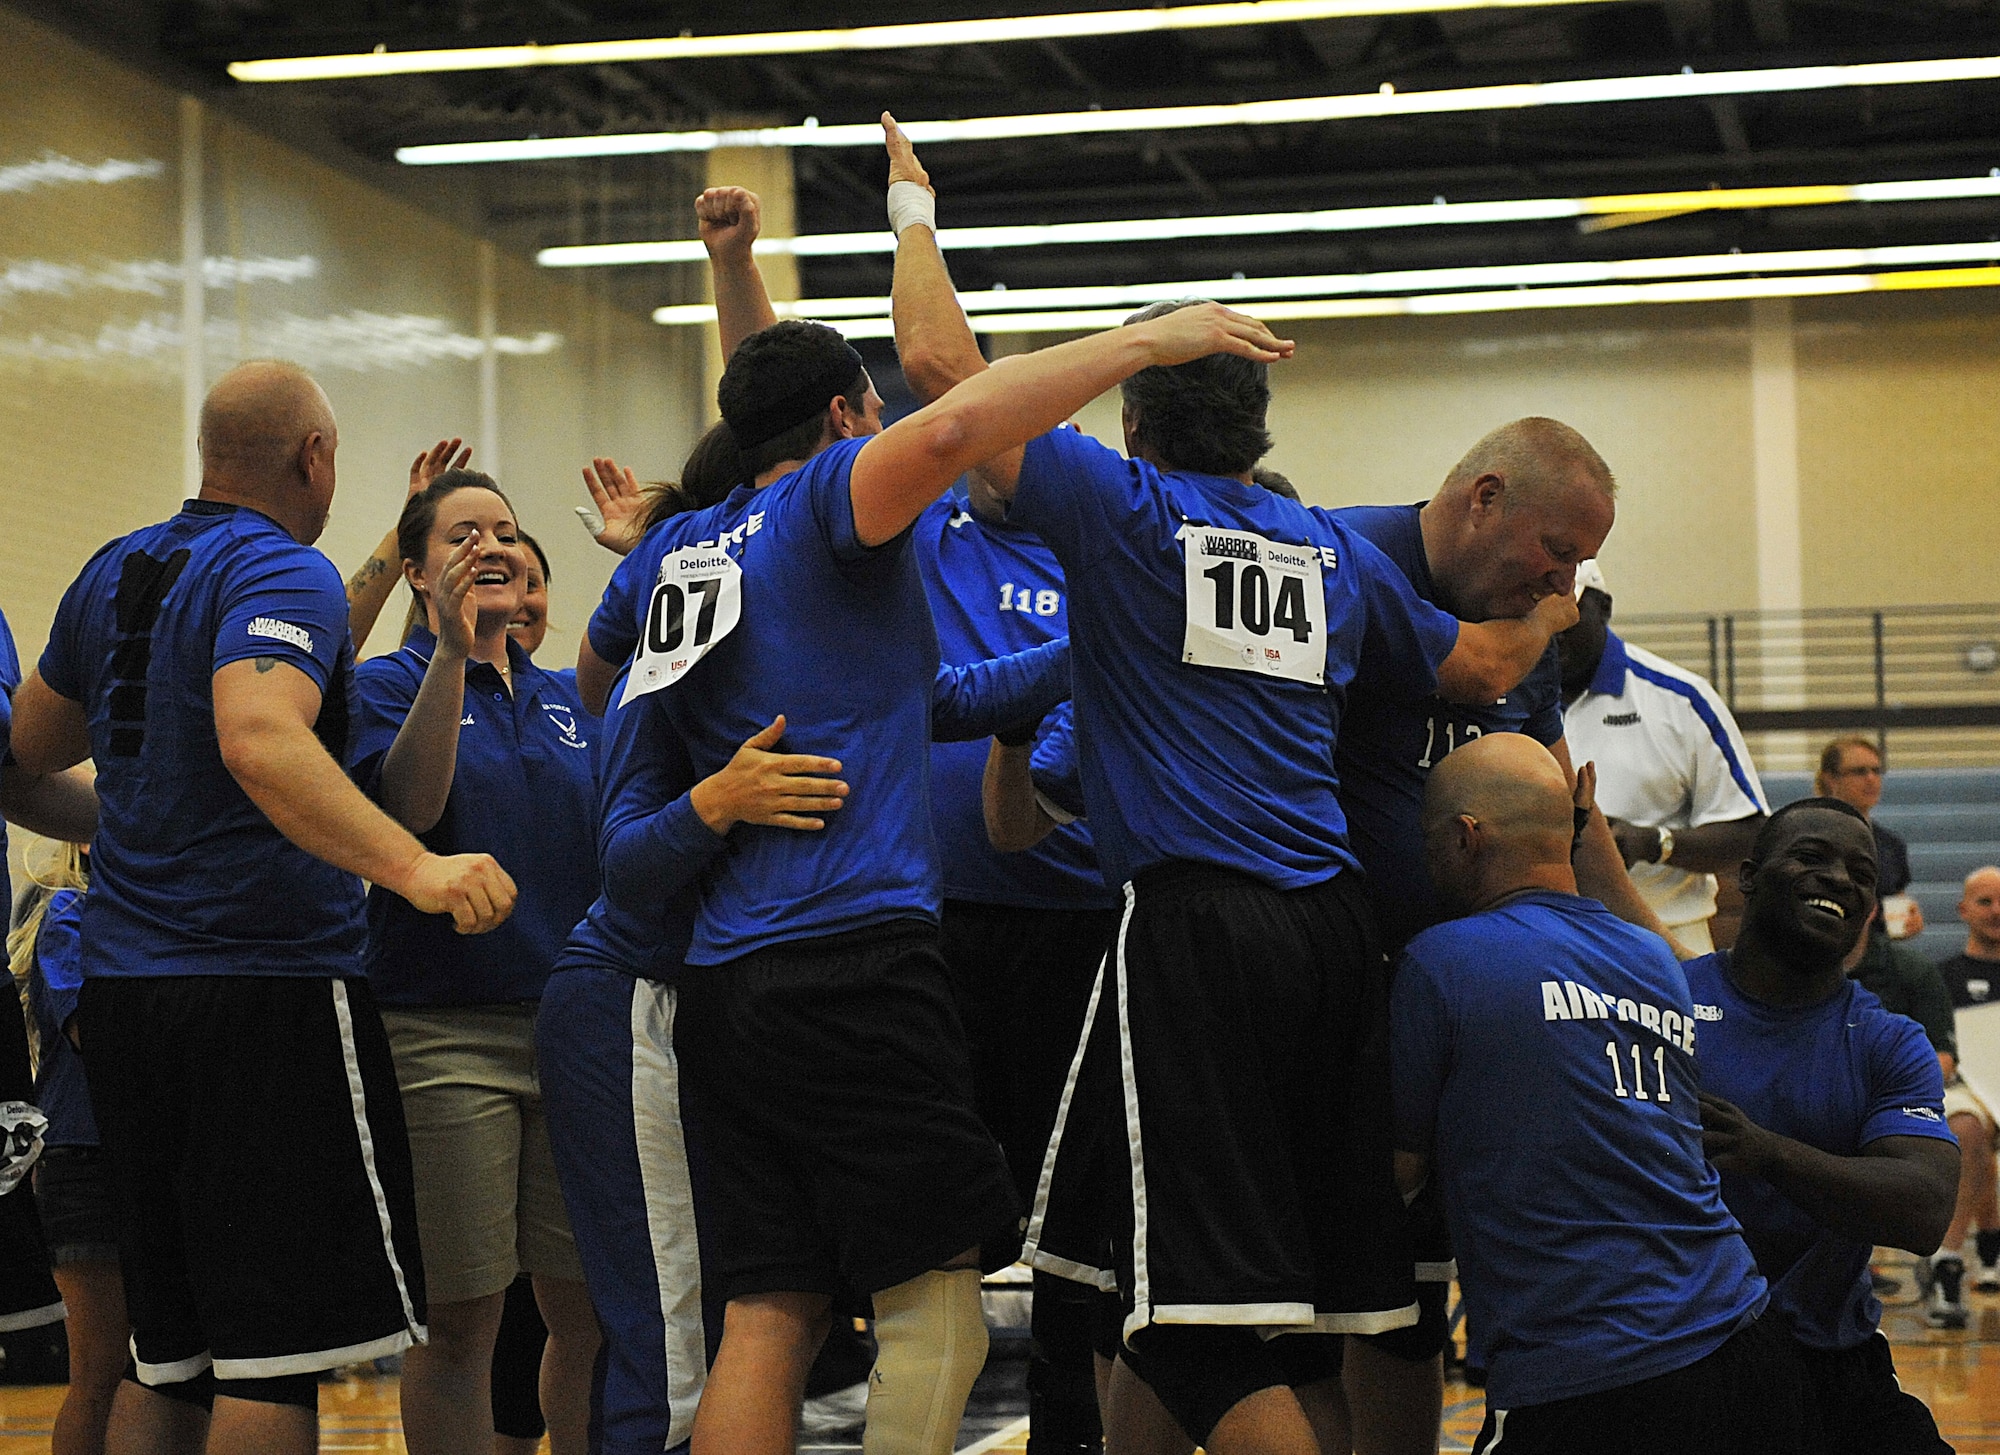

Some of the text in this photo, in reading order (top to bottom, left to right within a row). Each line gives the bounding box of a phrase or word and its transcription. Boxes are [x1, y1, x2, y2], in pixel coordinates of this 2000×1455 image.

[1205, 535, 1258, 555] WARRIOR
[999, 583, 1060, 617] 118
[1203, 561, 1313, 644] 104
[636, 578, 722, 663] 07
[671, 659, 688, 671] USA
[1264, 648, 1281, 660] USA
[1605, 1041, 1671, 1102] 111
